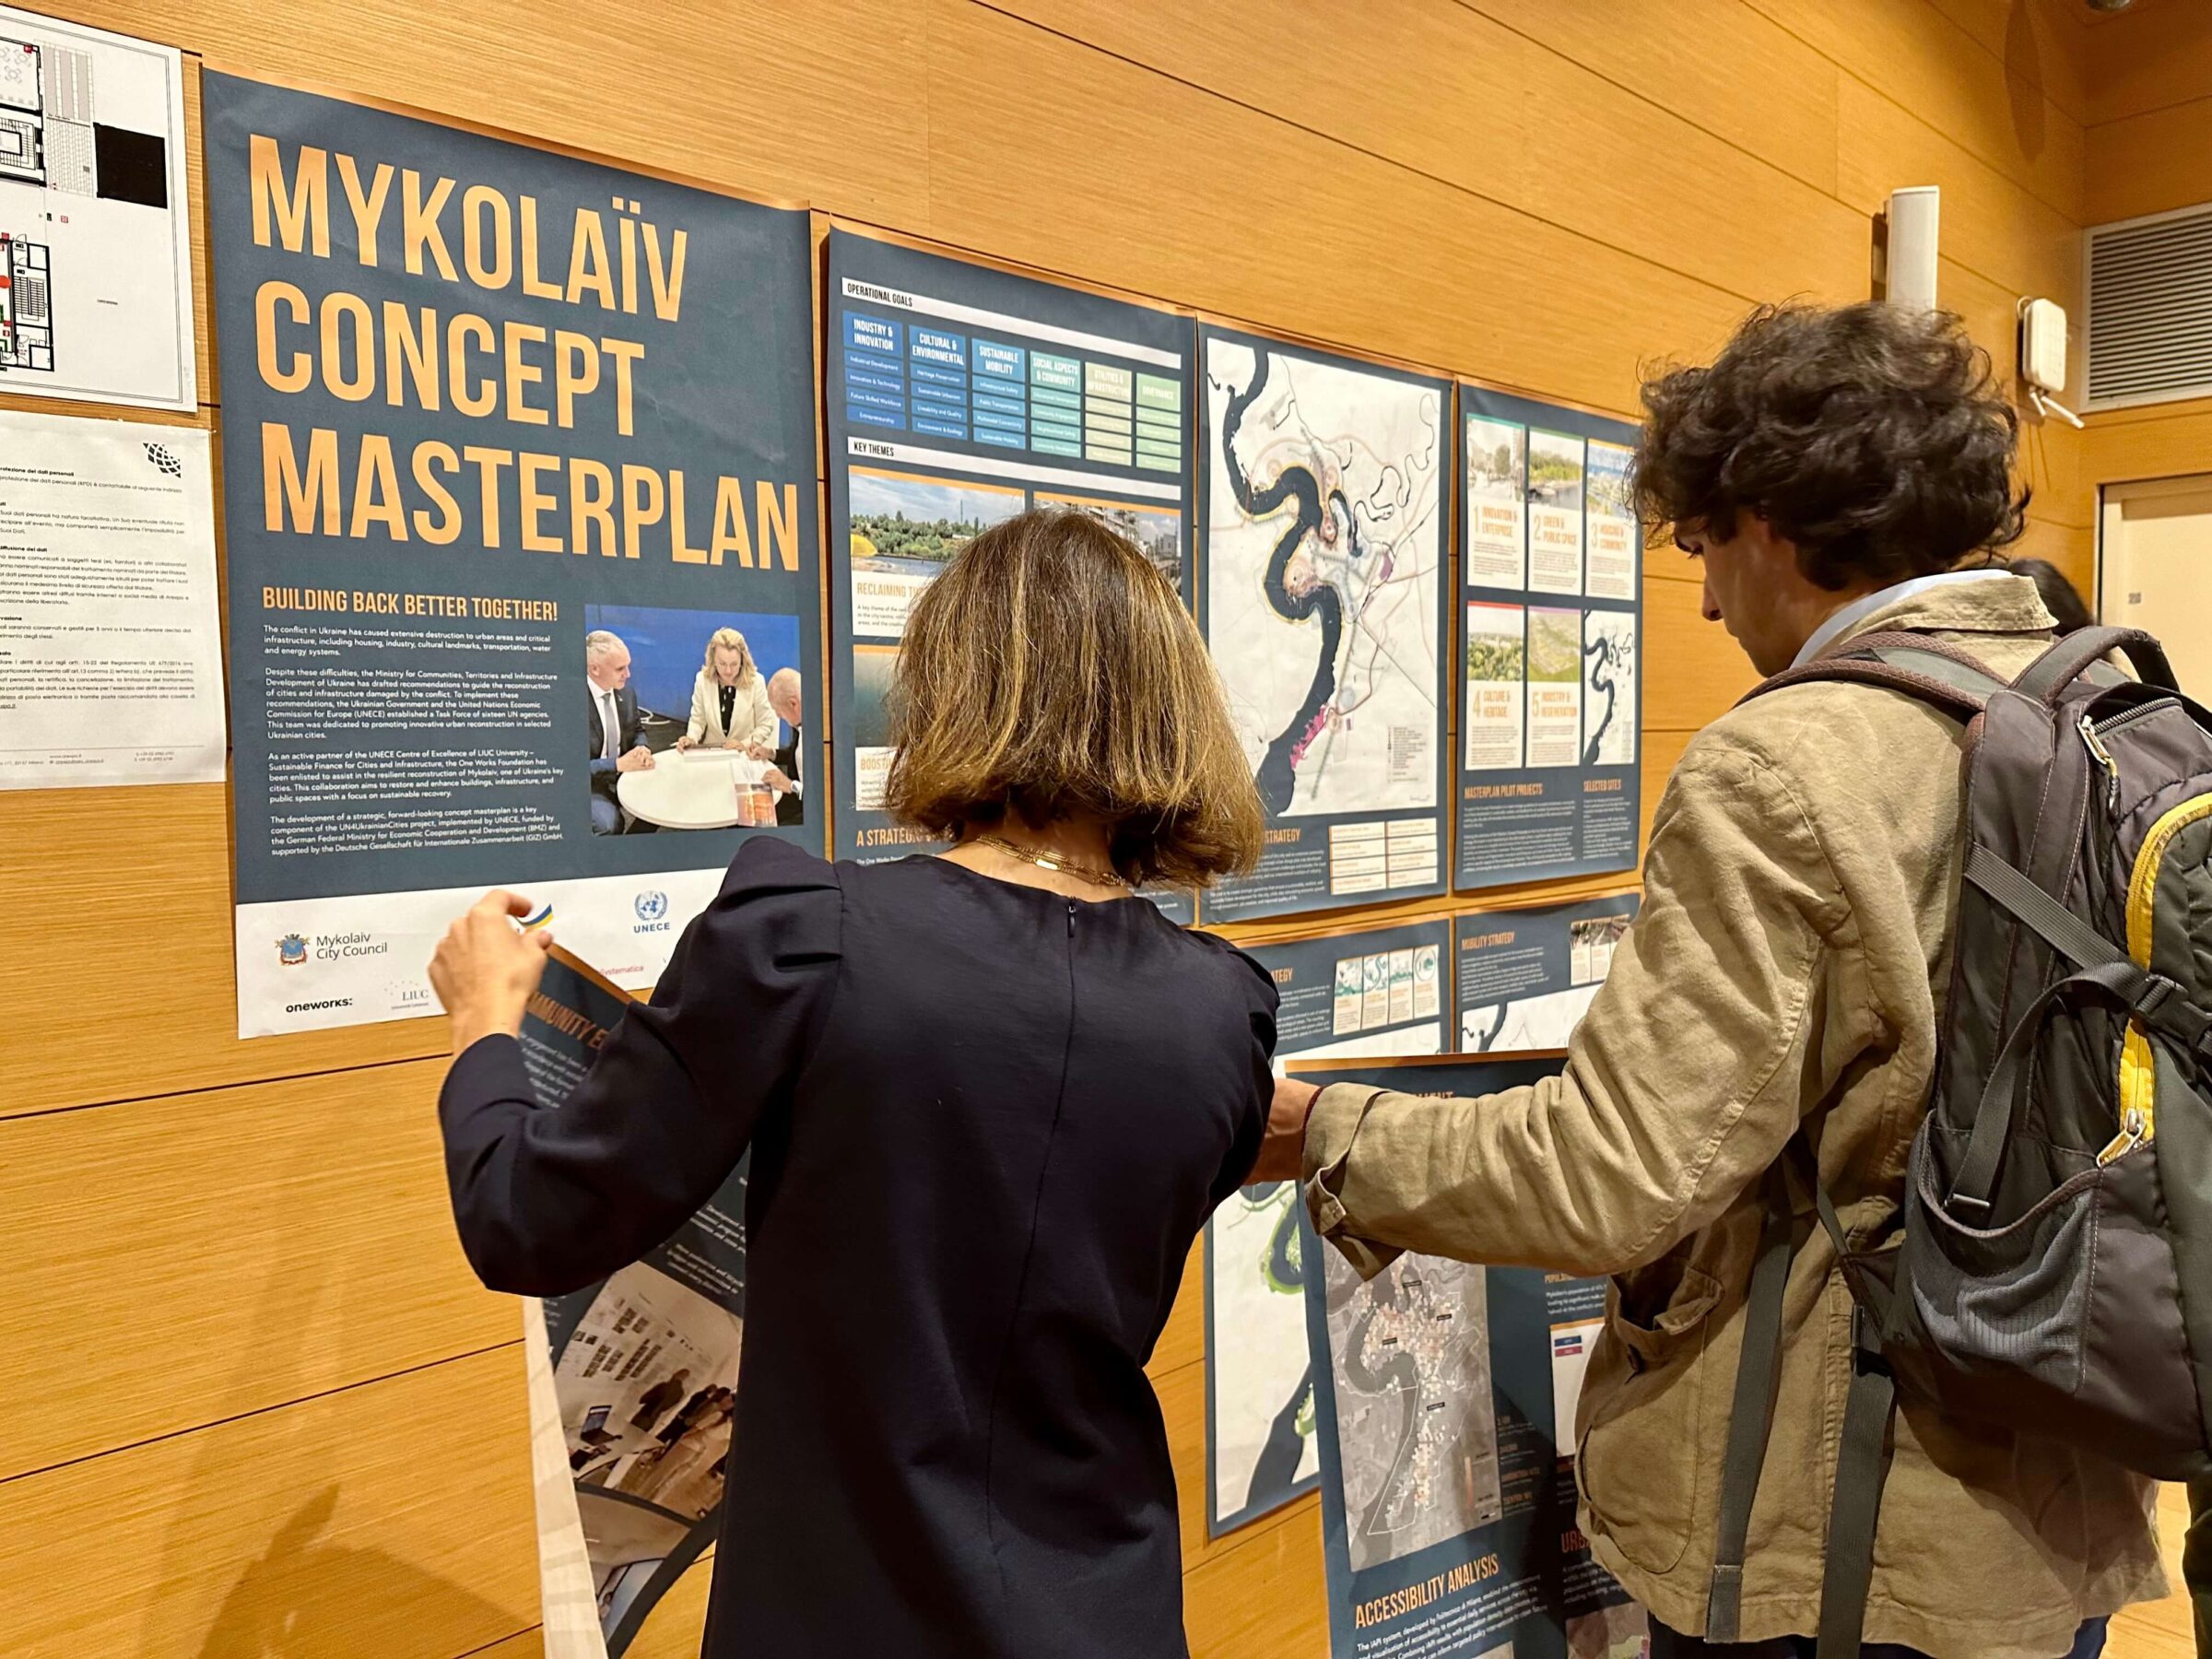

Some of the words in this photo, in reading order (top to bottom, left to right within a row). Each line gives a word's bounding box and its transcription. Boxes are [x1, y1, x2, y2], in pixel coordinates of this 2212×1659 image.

[250, 133, 688, 323] MYKOLAÏV
[847, 283, 891, 302] OPERATIONAL
[892, 294, 913, 307] GOALS
[854, 318, 886, 336] INDUSTRY
[854, 333, 894, 351] INNOVATION
[919, 333, 951, 349] CULTURAL
[255, 281, 645, 437] CONCEPT
[912, 345, 965, 366] ENVIRONMENTAL
[979, 345, 1018, 363] SUSTAINABLE
[985, 360, 1013, 375] MOBILITY
[853, 441, 866, 454] KEY
[868, 443, 894, 457] THEMES
[261, 422, 800, 571] MASTERPLAN
[1534, 515, 1541, 541] 2
[1591, 523, 1598, 548] 3
[857, 582, 906, 598] RECLAIMING
[263, 587, 347, 612] BUILDING
[353, 591, 399, 614] BACK
[404, 594, 467, 617] BETTER
[471, 597, 558, 621] TOGETHER!
[264, 625, 278, 633] The
[280, 625, 307, 634] conflict
[309, 626, 317, 634] in
[318, 626, 347, 635] Ukraine
[348, 627, 362, 636] has
[363, 628, 389, 637] caused
[390, 629, 424, 638] extensive
[425, 630, 464, 639] destruction
[465, 631, 474, 639] to
[474, 631, 494, 640] urban
[514, 633, 527, 641] and
[528, 633, 550, 642] critical
[264, 646, 279, 654] and
[280, 648, 307, 656] energy
[318, 637, 353, 648] including
[417, 640, 444, 648] cultural
[532, 643, 551, 652] water
[265, 667, 295, 677] Despite
[296, 668, 317, 676] these
[361, 668, 373, 676] the
[375, 668, 404, 679] Ministry
[405, 669, 415, 677] for
[465, 670, 499, 679] Territories
[500, 671, 513, 679] and
[514, 671, 557, 680] Infrastructure
[265, 678, 315, 688] Development
[326, 678, 355, 687] Ukraine
[356, 679, 369, 687] has
[371, 679, 398, 687] drafted
[399, 679, 461, 688] recommendations
[470, 680, 490, 690] guide
[491, 680, 503, 688] the
[504, 681, 551, 689] reconstruction
[314, 689, 364, 697] infrastructure
[365, 689, 399, 699] damaged
[400, 689, 410, 699] by
[463, 690, 498, 700] implement
[499, 690, 519, 698] these
[350, 699, 384, 707] Ukrainian
[385, 699, 429, 707] Government
[458, 699, 481, 707] United
[482, 700, 509, 708] Nations
[509, 700, 540, 708] Economic
[1473, 690, 1480, 717] 4
[1532, 692, 1539, 717] 5
[1464, 786, 1500, 799] MASTERPLAN
[1500, 785, 1516, 797] PILOT
[1516, 783, 1543, 796] PROJECTS
[1583, 780, 1607, 793] SELECTED
[1607, 779, 1621, 791] SITES
[857, 830, 864, 847] A
[1264, 828, 1301, 844] STRATEGY
[634, 922, 670, 933] UNECE
[316, 933, 371, 947] Mykolaiv
[1462, 935, 1488, 951] MOBILITY
[1489, 932, 1515, 947] STRATEGY
[316, 947, 340, 961] City
[343, 943, 388, 957] Council
[402, 990, 429, 1001] LIUC
[1355, 1574, 1445, 1630] ACCESSIBILITY
[1448, 1553, 1499, 1594] ANALYSIS
